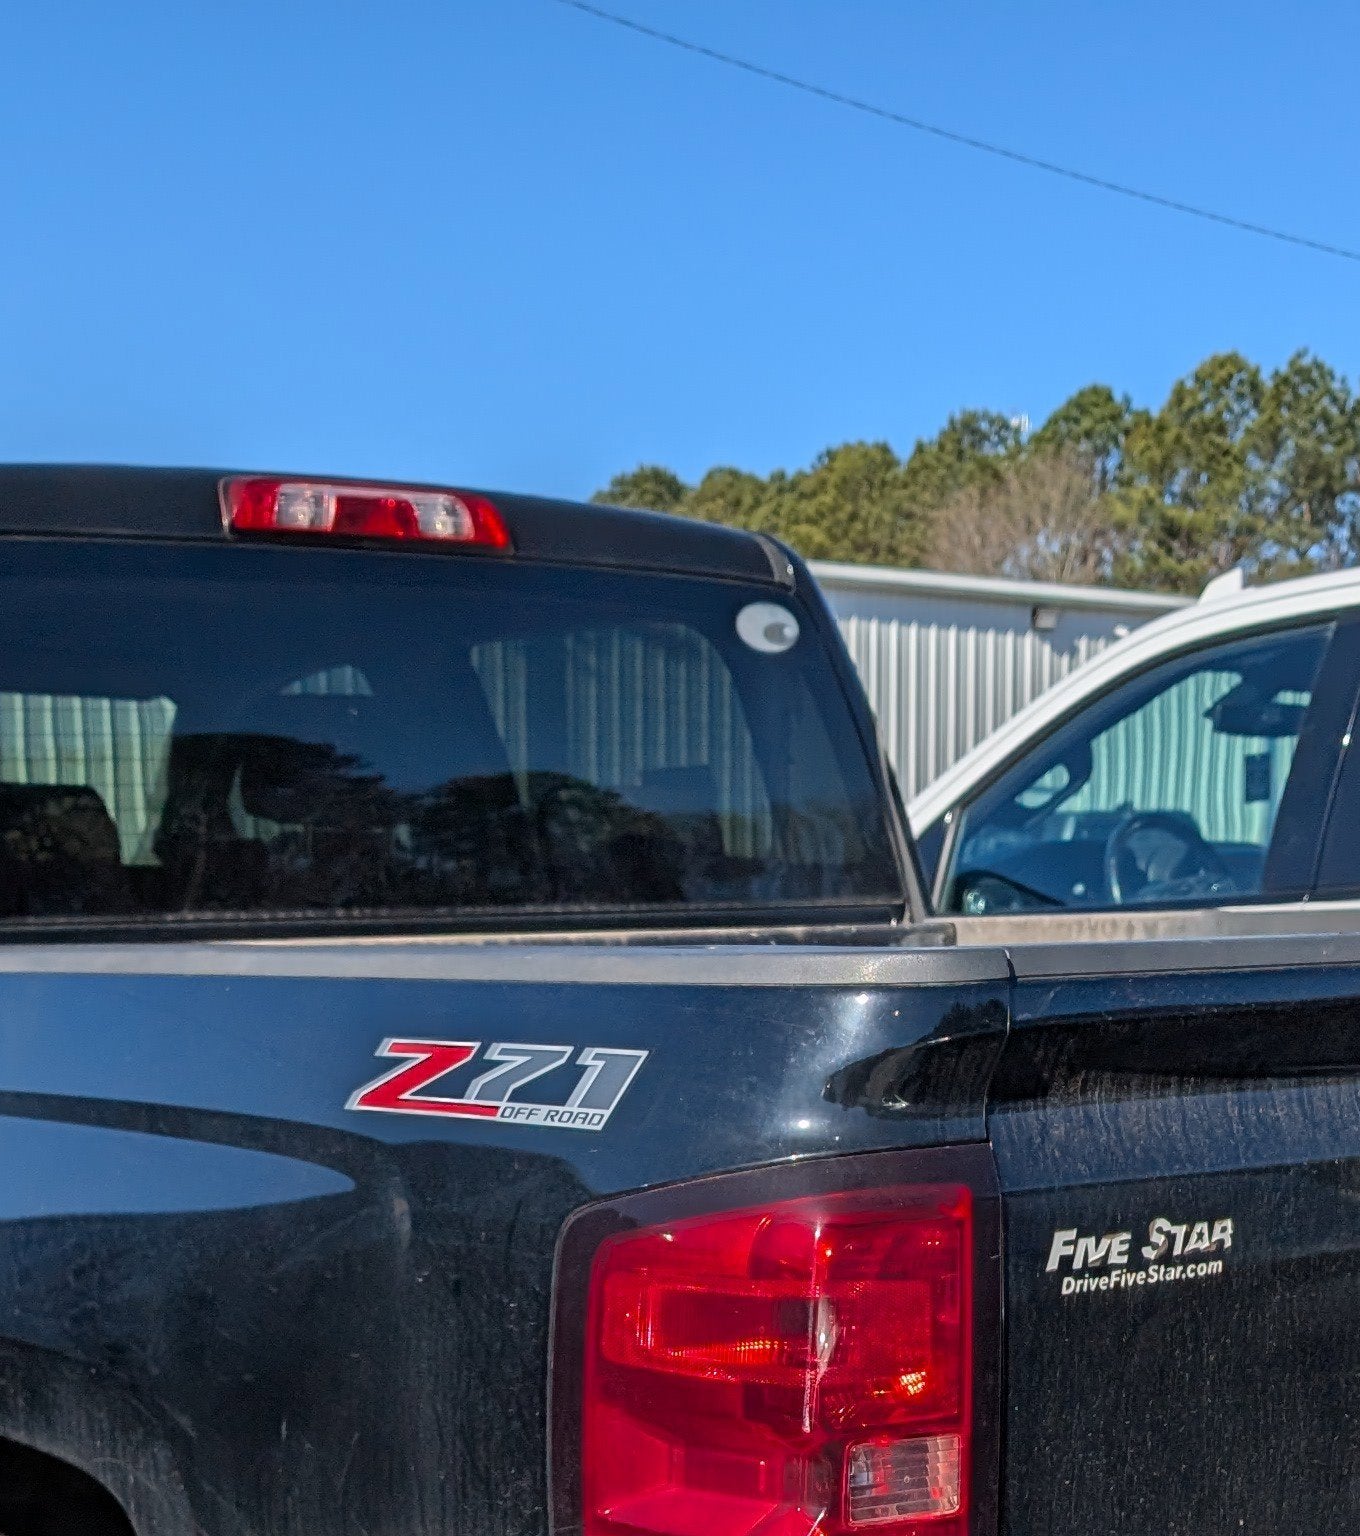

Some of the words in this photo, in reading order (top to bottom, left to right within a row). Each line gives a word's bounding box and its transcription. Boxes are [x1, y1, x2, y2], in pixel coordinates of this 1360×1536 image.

[344, 1037, 649, 1119] Z71
[499, 1105, 541, 1121] OFF
[543, 1108, 605, 1127] ROAD
[1061, 1259, 1223, 1296] DriveFiveStar.com
